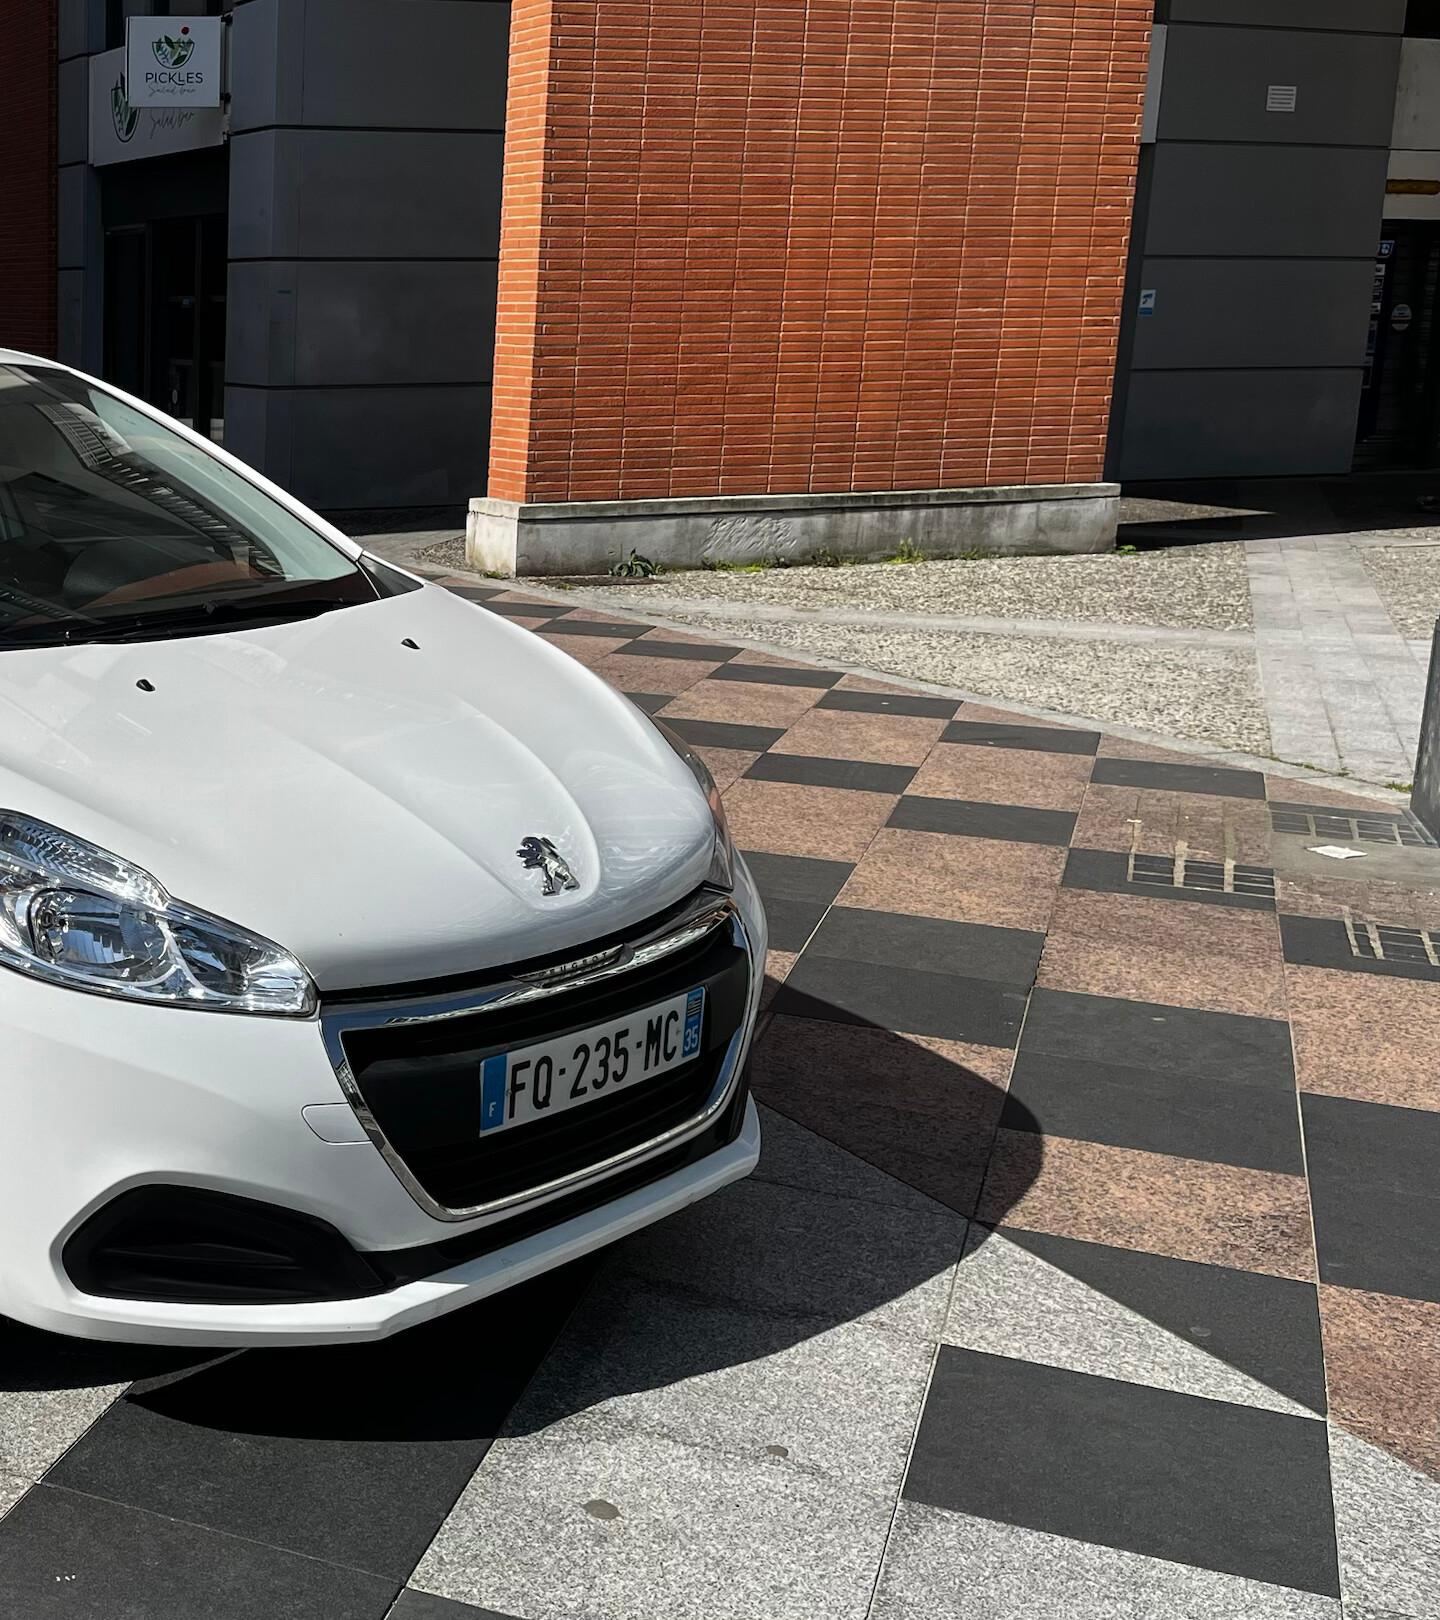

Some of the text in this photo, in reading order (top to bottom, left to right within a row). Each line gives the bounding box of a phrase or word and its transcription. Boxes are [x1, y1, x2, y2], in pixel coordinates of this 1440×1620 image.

[145, 72, 204, 86] PICKLES
[538, 951, 608, 977] PEUGEOT
[488, 1101, 497, 1118] F
[683, 1025, 699, 1052] 35
